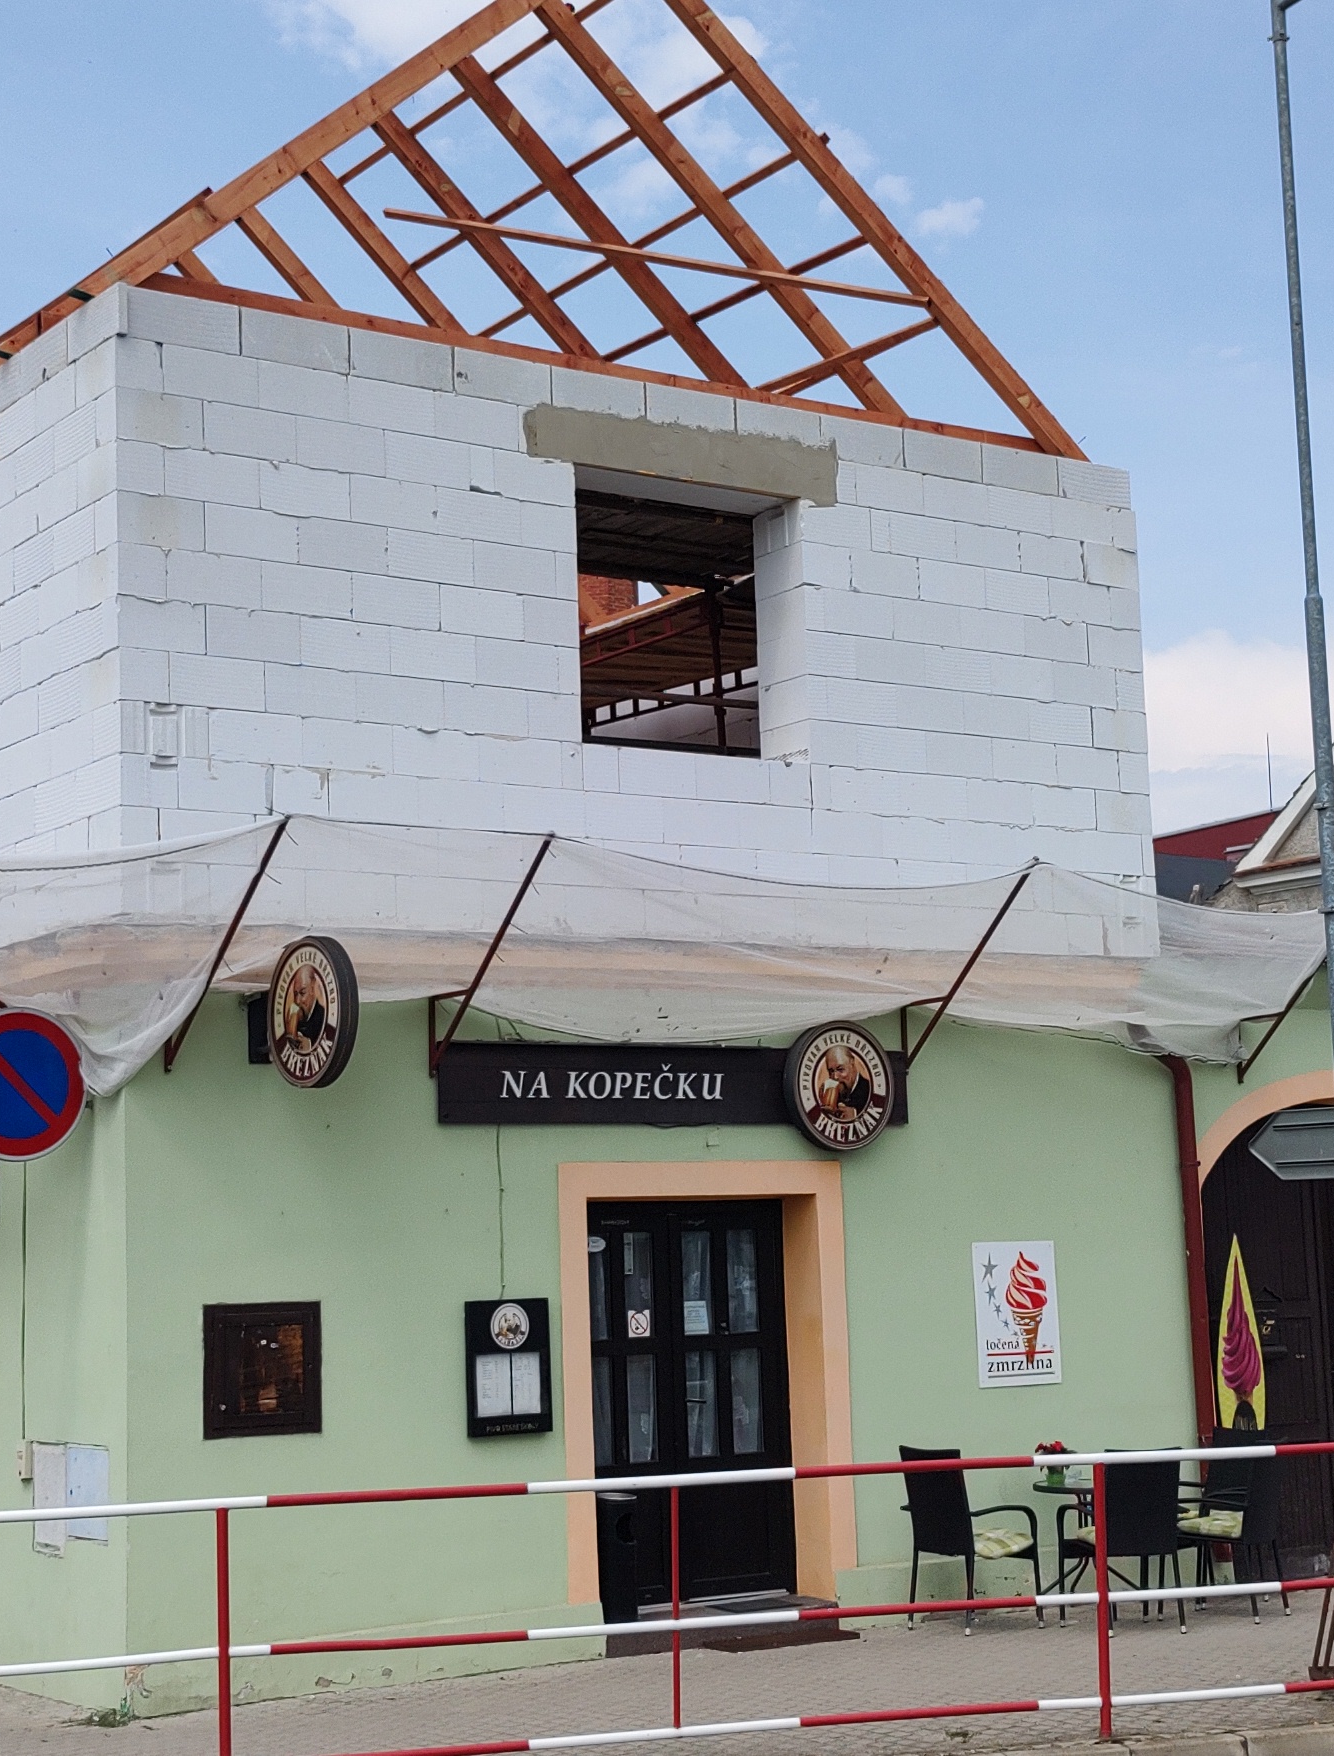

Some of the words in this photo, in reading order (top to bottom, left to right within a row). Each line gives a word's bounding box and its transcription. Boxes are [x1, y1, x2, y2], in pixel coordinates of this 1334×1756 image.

[276, 963, 295, 1015] PIVOVAR
[295, 950, 317, 965] VELKÉ
[500, 1070, 550, 1099] NA
[565, 1063, 725, 1100] KOPEČKU
[802, 1043, 822, 1091] PIVOVAR
[822, 1032, 852, 1046] VELKÉ
[854, 1039, 882, 1077] BŘEZNO
